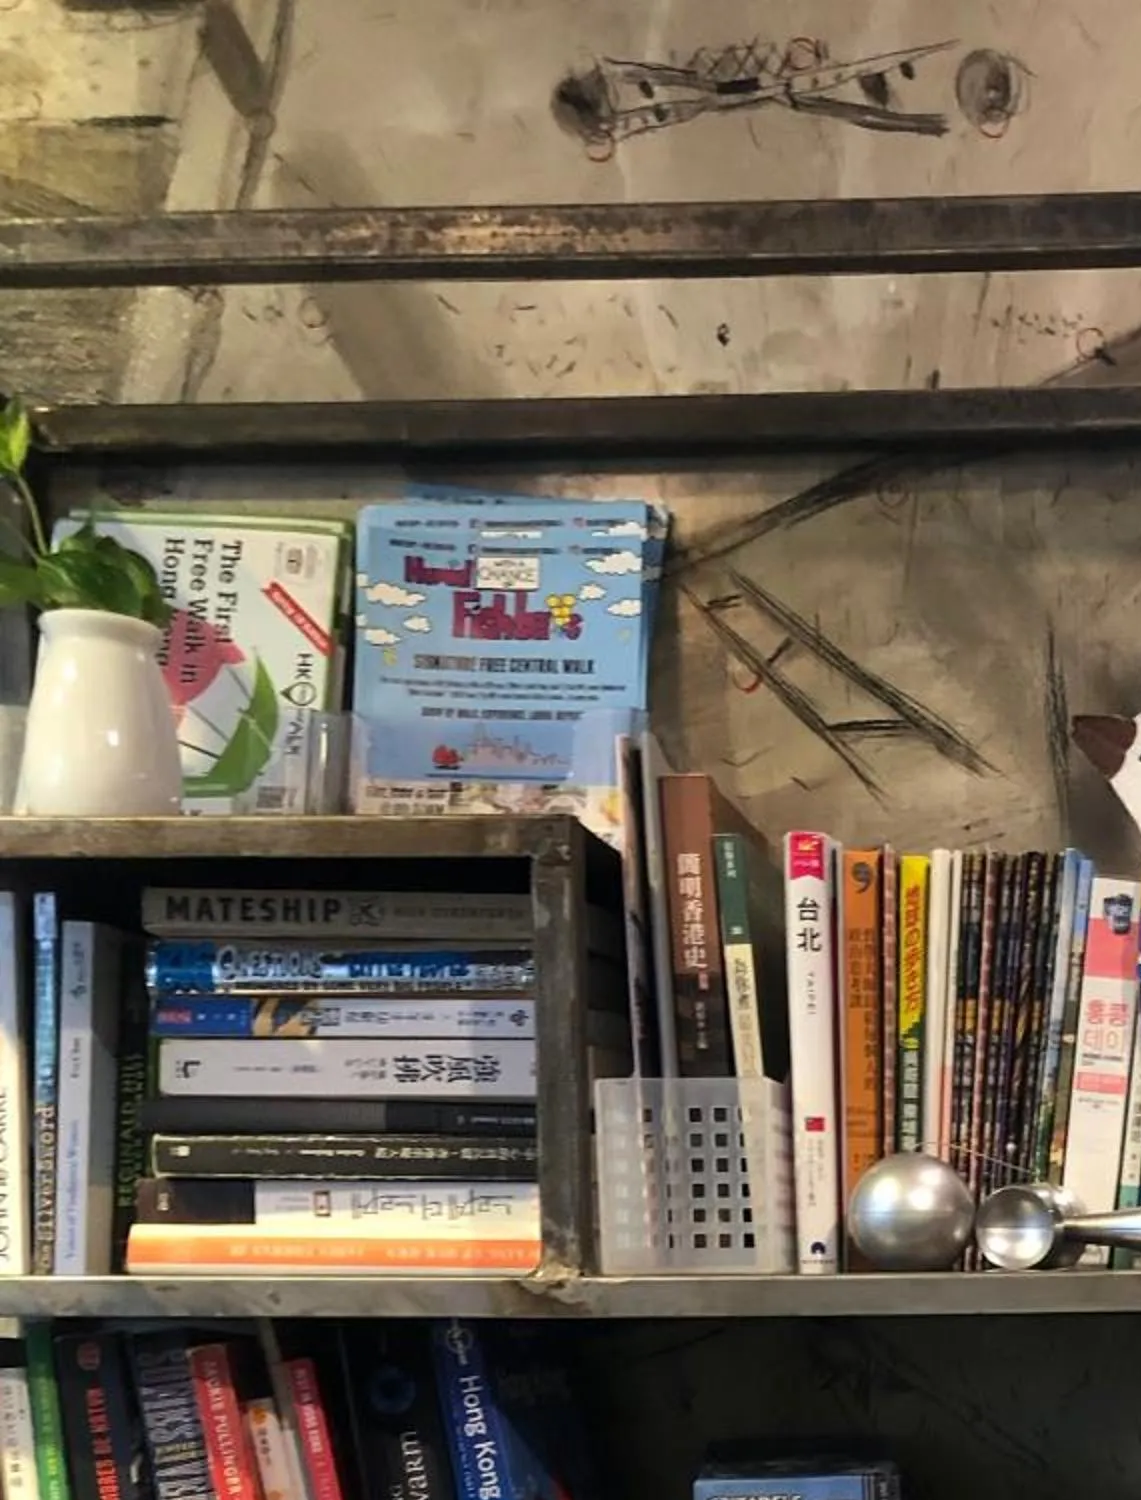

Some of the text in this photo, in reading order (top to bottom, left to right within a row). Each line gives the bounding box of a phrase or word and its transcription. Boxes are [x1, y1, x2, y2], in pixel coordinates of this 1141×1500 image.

[180, 539, 214, 683] Free Walk in
[215, 540, 243, 643] The First
[165, 895, 342, 924] MATESHIP
[796, 897, 822, 953] 台北
[213, 1415, 243, 1498] PULLINGER
[461, 1375, 502, 1500] Hong Kong
